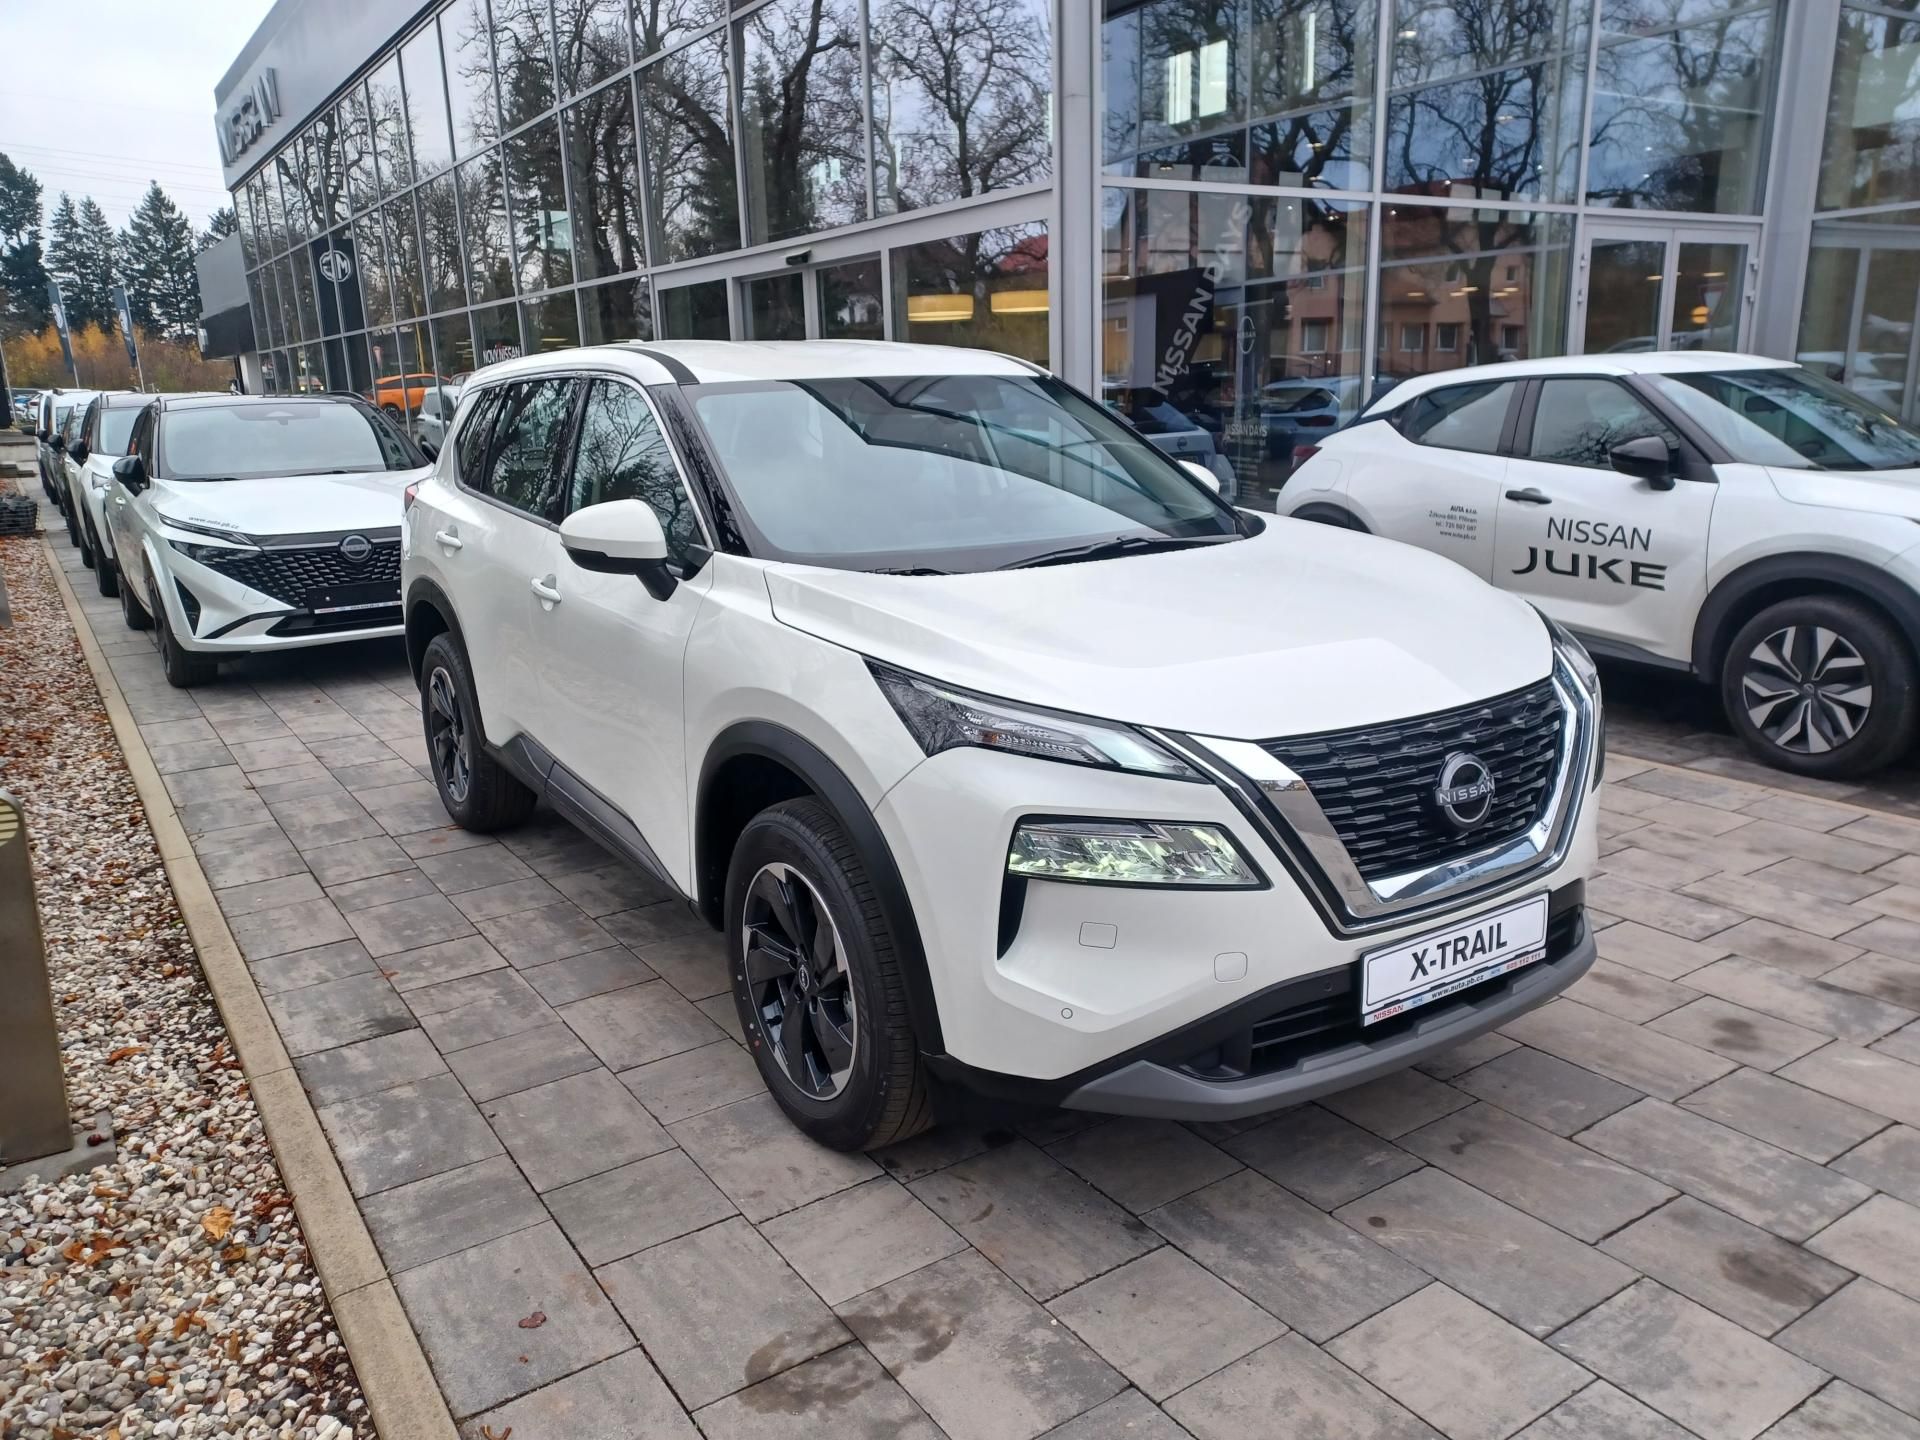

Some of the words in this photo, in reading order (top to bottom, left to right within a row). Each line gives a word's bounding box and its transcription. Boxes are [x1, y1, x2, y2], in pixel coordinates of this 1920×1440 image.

[1153, 287, 1213, 396] NISSAN
[1203, 202, 1252, 283] DAYS
[1547, 516, 1652, 551] NISSAN
[1512, 546, 1667, 591] JUKE
[1440, 777, 1494, 804] NISSAN
[1410, 922, 1507, 981] X-TRAIL
[1374, 1004, 1404, 1020] NISSAN
[1432, 975, 1484, 999] www.auta.pb.cz
